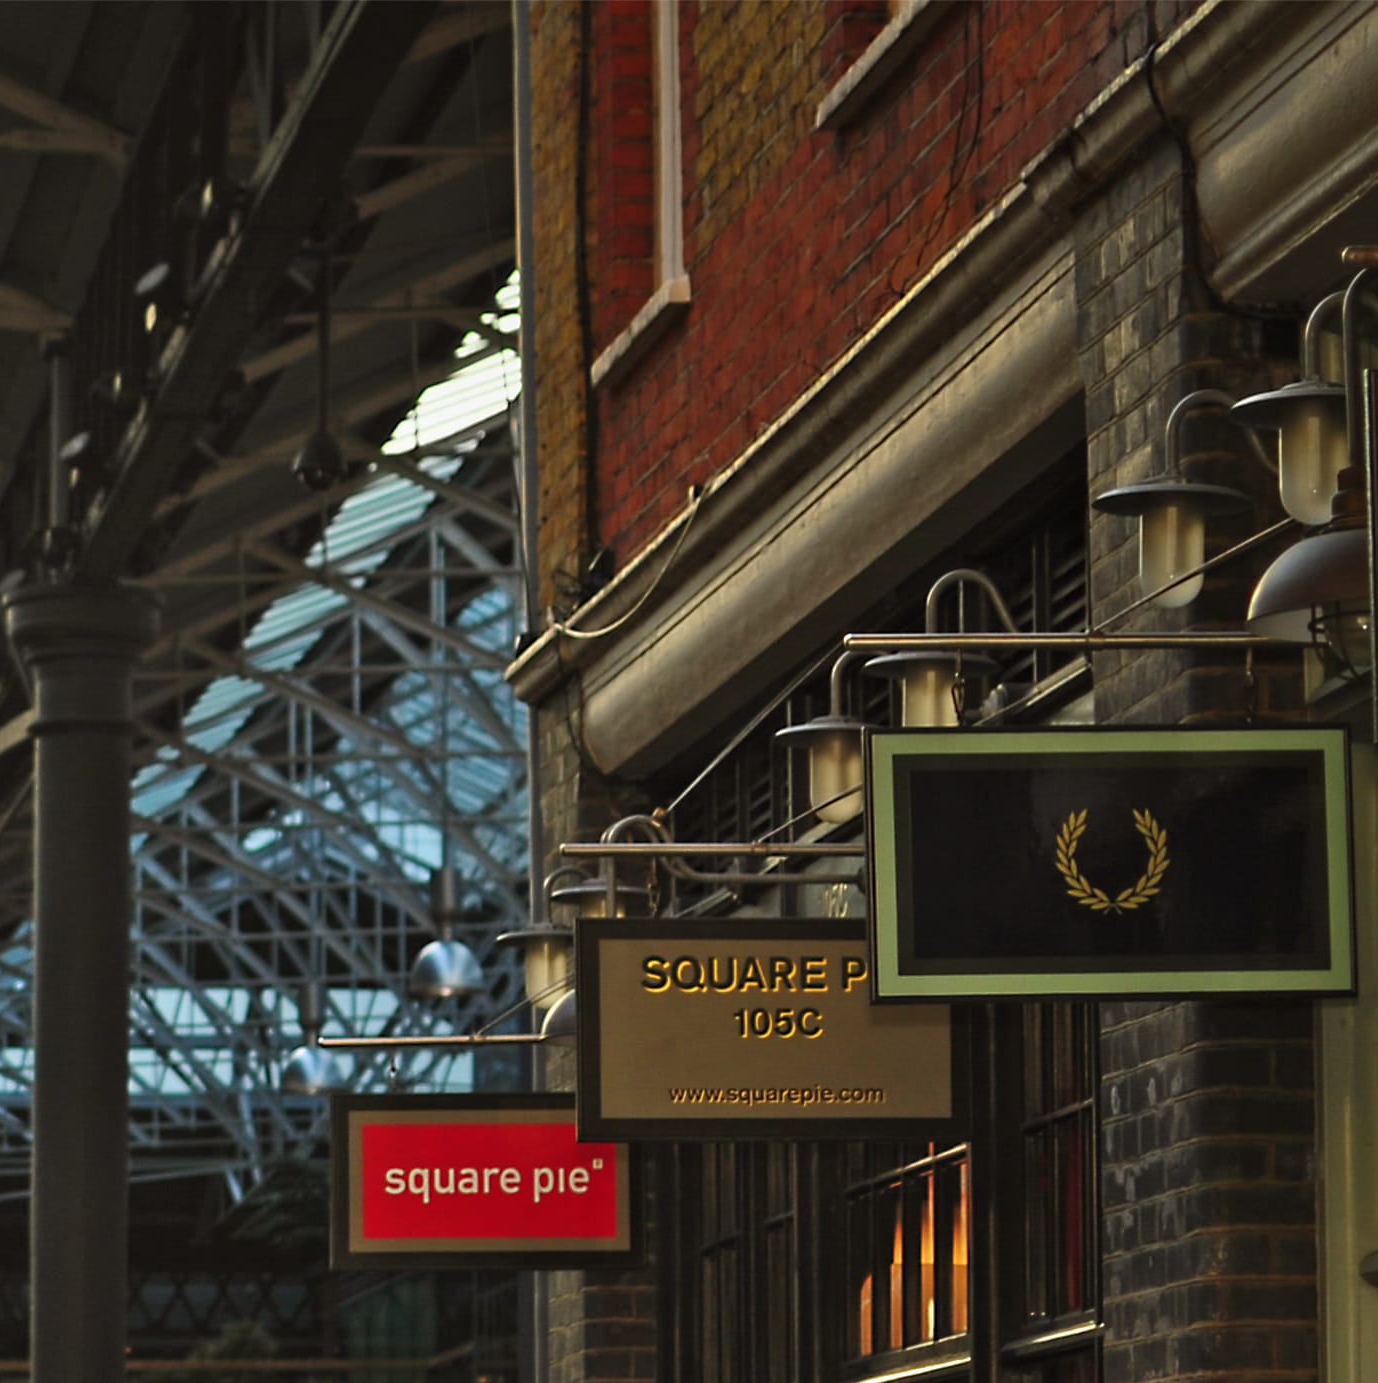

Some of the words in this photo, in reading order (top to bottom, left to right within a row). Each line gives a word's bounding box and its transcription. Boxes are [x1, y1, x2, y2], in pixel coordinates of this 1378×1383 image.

[641, 955, 828, 993] SQUARE
[734, 1008, 824, 1039] 105C
[668, 1084, 886, 1106] www.squarepie.com
[385, 1166, 522, 1205] square
[533, 1166, 591, 1204] pie
